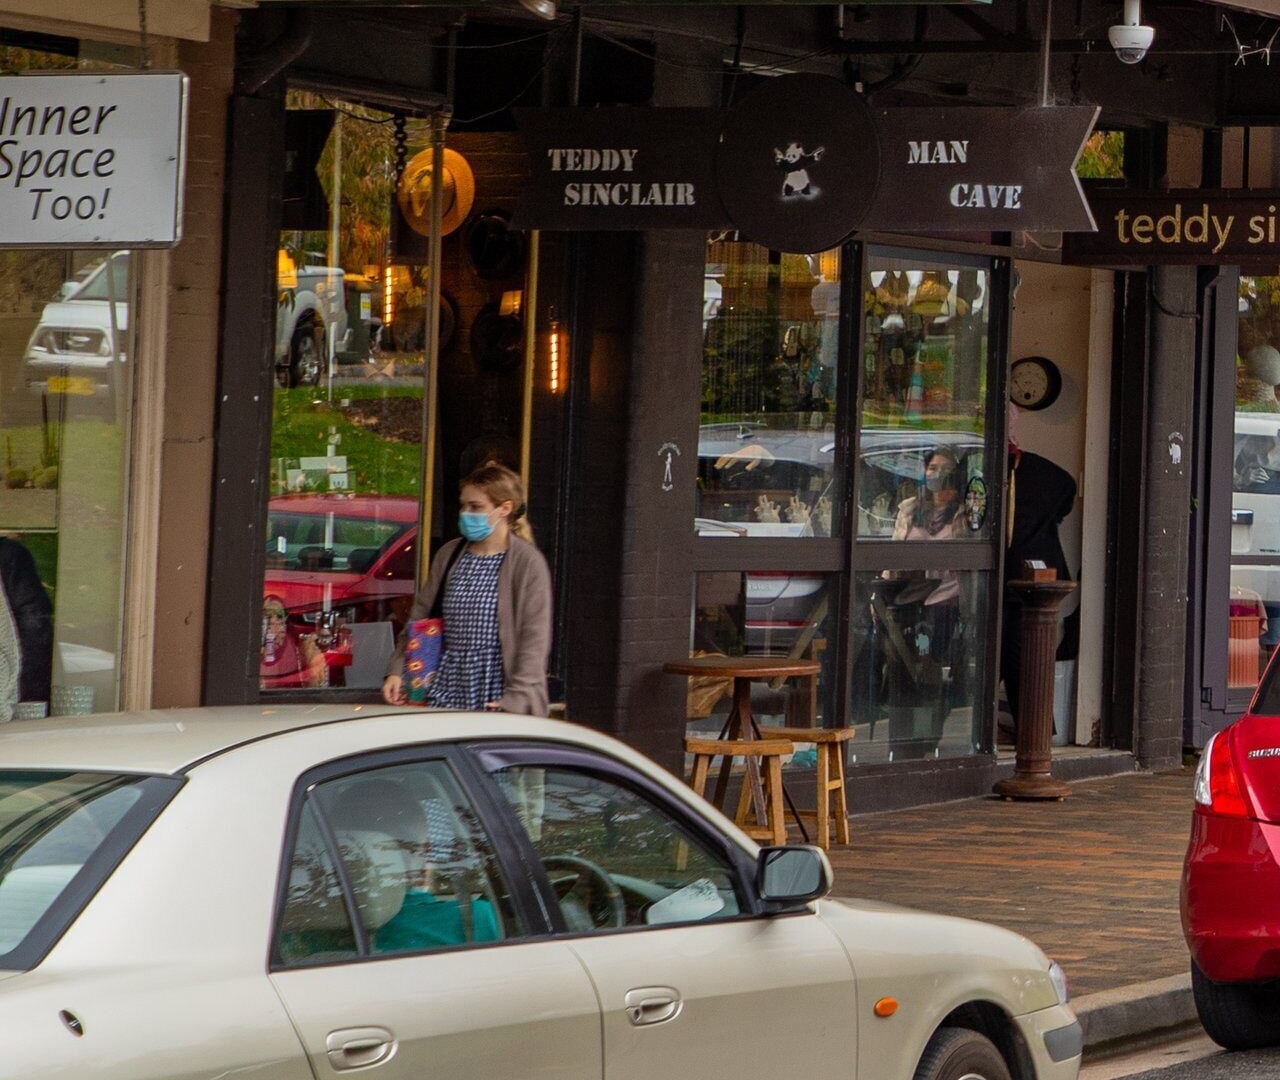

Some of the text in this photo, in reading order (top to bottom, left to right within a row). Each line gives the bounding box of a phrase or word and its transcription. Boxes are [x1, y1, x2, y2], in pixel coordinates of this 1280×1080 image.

[0, 96, 118, 136] Inner
[0, 139, 116, 188] Space
[547, 140, 970, 172] TEDDY MAN
[29, 187, 111, 221] Too!
[563, 182, 1022, 210] SINCLAIR CAVE
[1114, 203, 1235, 255] teddy
